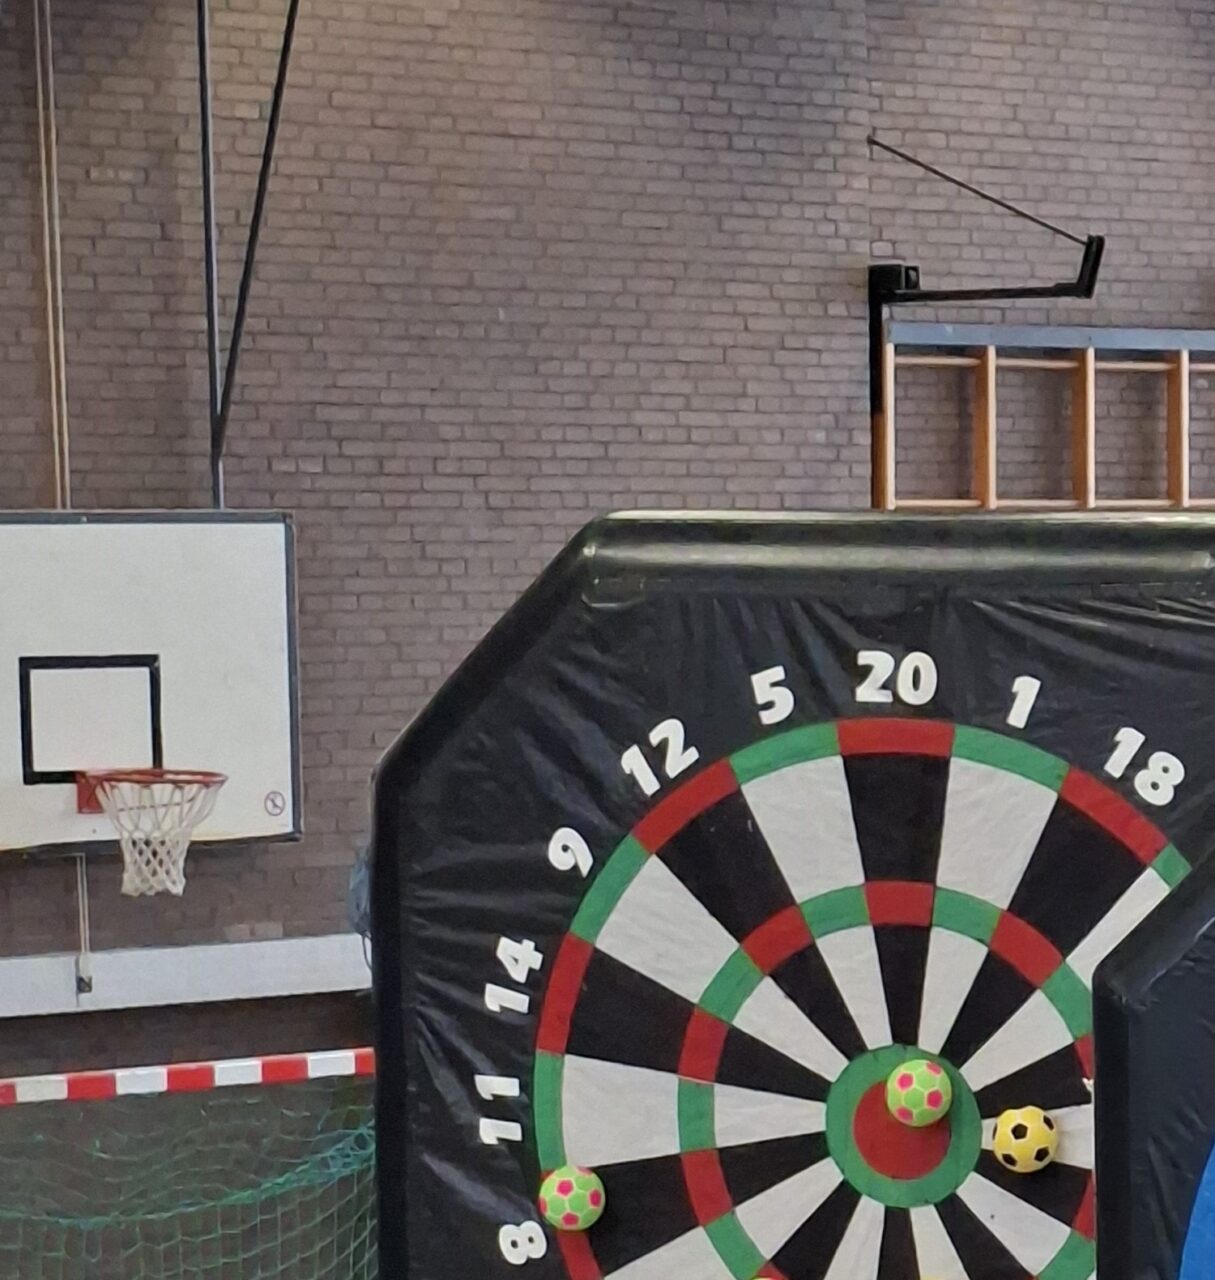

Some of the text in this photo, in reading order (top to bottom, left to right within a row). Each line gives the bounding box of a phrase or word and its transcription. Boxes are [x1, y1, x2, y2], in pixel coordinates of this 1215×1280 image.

[749, 664, 796, 726] 5
[854, 649, 939, 707] 20
[1005, 674, 1043, 730] 1
[619, 717, 701, 798] 12
[1102, 725, 1186, 807] 18
[546, 826, 595, 879] 9
[483, 935, 545, 1015] 14
[473, 1073, 523, 1146] 11
[497, 1219, 548, 1266] 8
